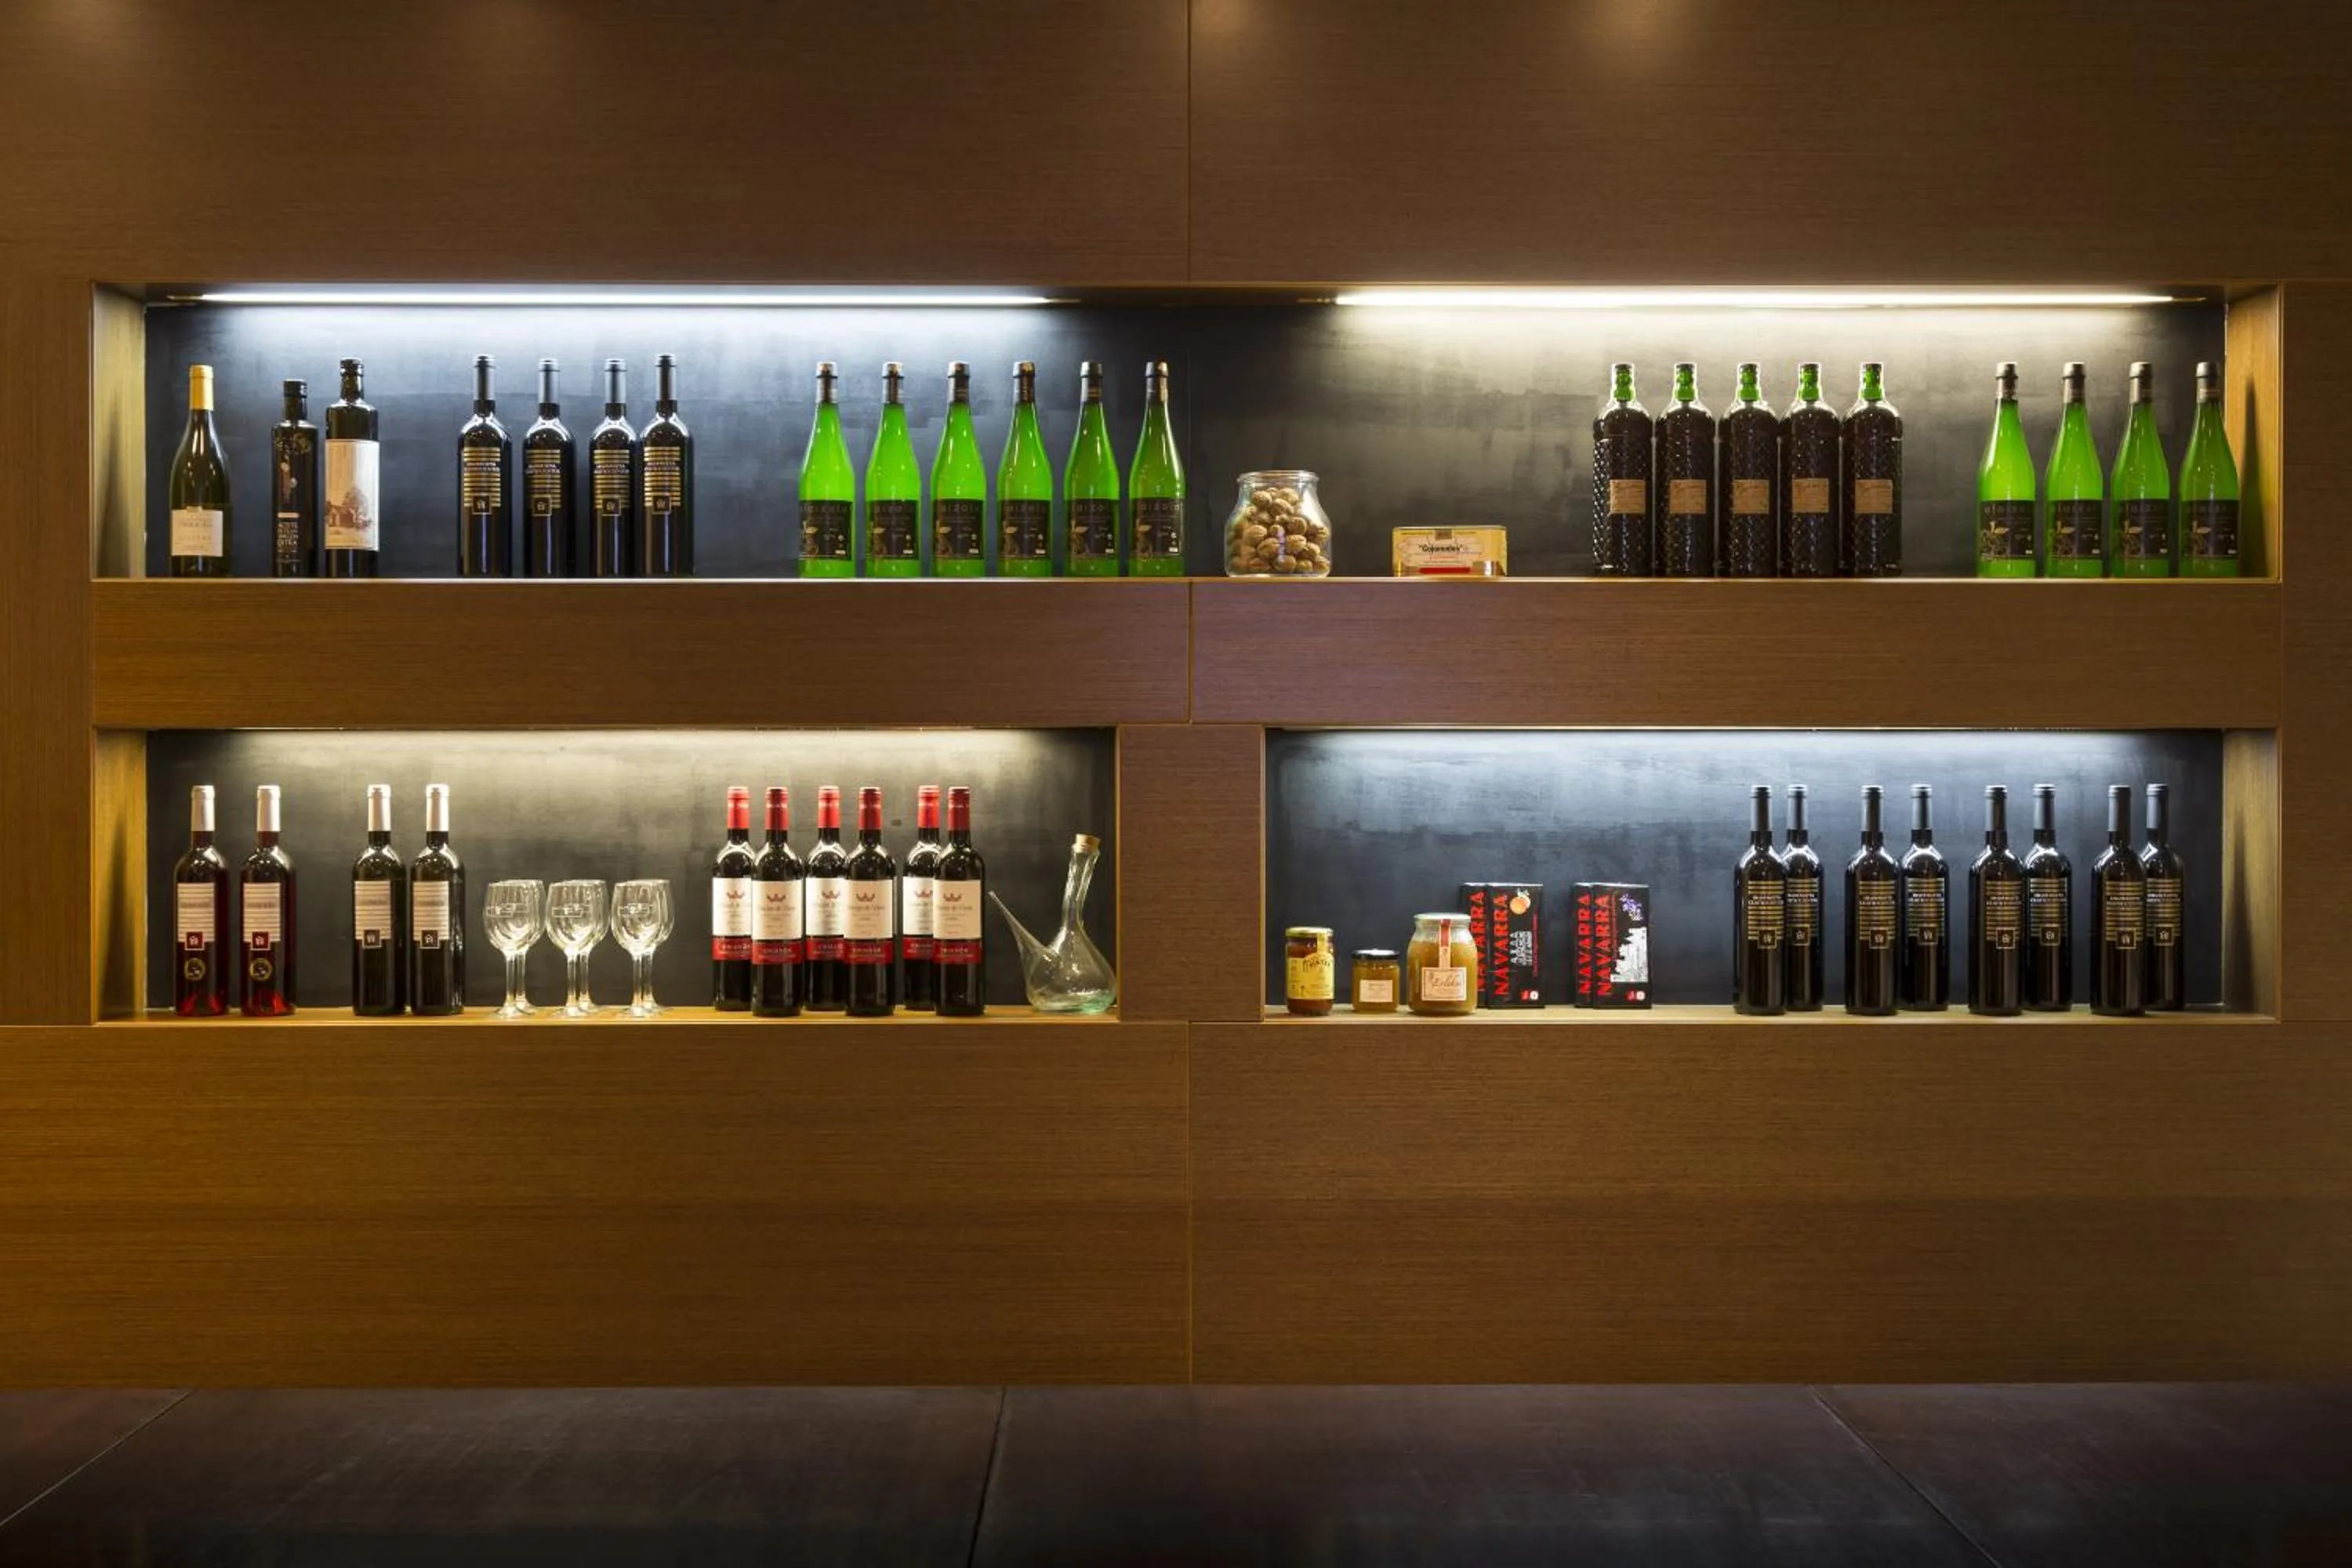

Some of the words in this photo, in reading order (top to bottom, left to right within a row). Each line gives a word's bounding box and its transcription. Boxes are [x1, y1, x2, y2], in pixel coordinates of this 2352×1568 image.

[1494, 895, 1509, 995] NAVARRA
[1578, 893, 1592, 994] NAVARRA
[1595, 893, 1612, 996] NAVARRA
